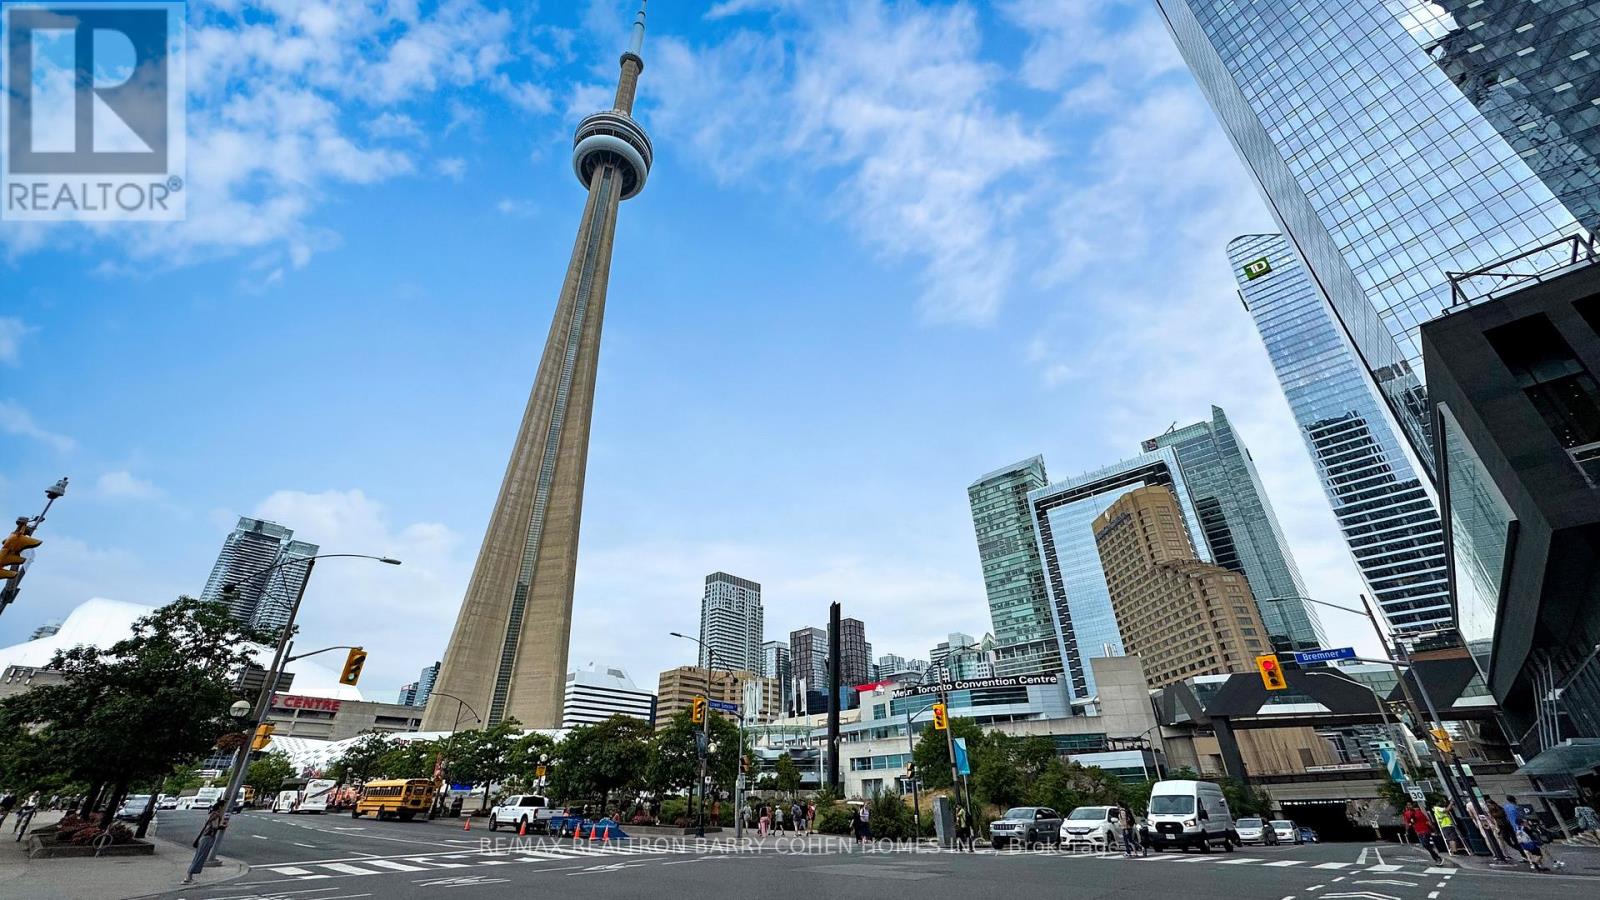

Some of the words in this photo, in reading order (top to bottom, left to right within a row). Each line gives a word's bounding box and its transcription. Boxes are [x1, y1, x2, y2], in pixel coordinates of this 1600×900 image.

[1246, 261, 1267, 274] TD
[1302, 650, 1339, 661] Bremner
[916, 684, 952, 695] Toronto
[955, 678, 1016, 691] Convention
[1017, 674, 1057, 686] Centre
[284, 696, 342, 711] CENTRE
[1411, 791, 1423, 800] 30
